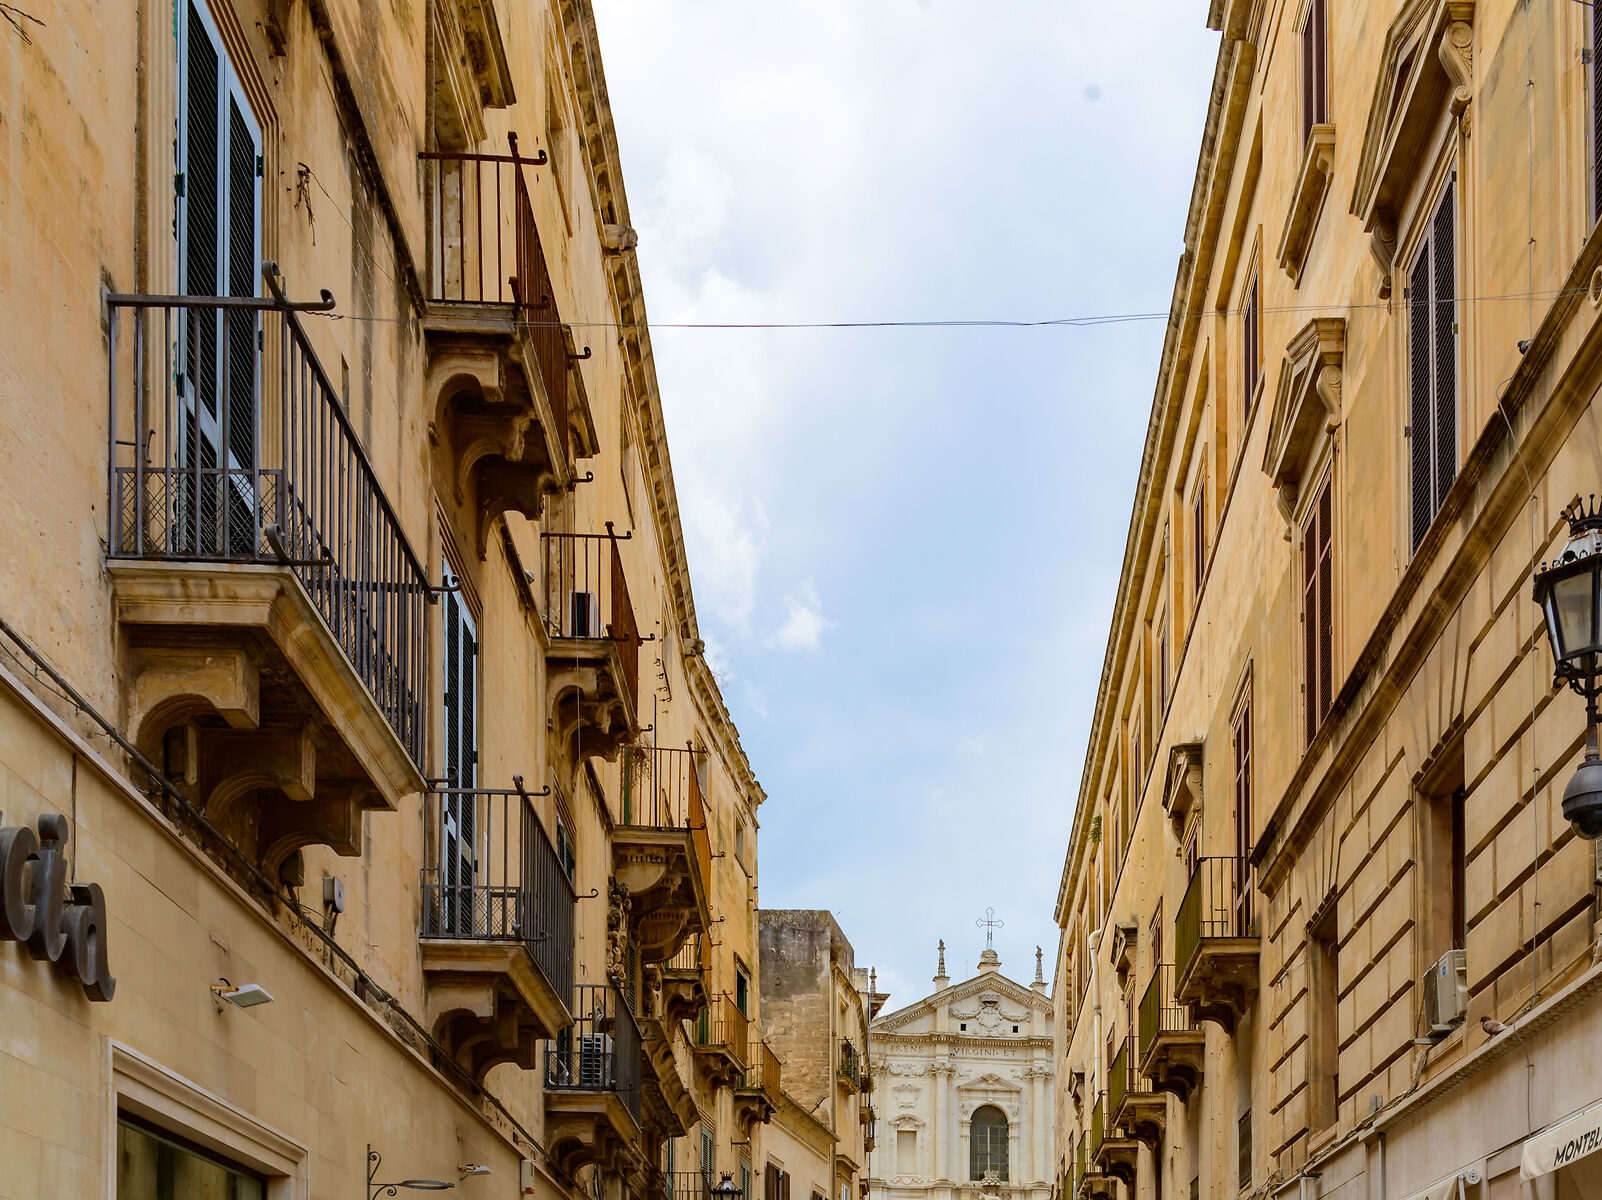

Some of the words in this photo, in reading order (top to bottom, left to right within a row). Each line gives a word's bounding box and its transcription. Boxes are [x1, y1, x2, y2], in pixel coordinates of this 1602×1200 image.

[0, 813, 116, 1002] cia
[1003, 1049, 1017, 1057] ET
[1554, 1126, 1602, 1167] MONTBL
